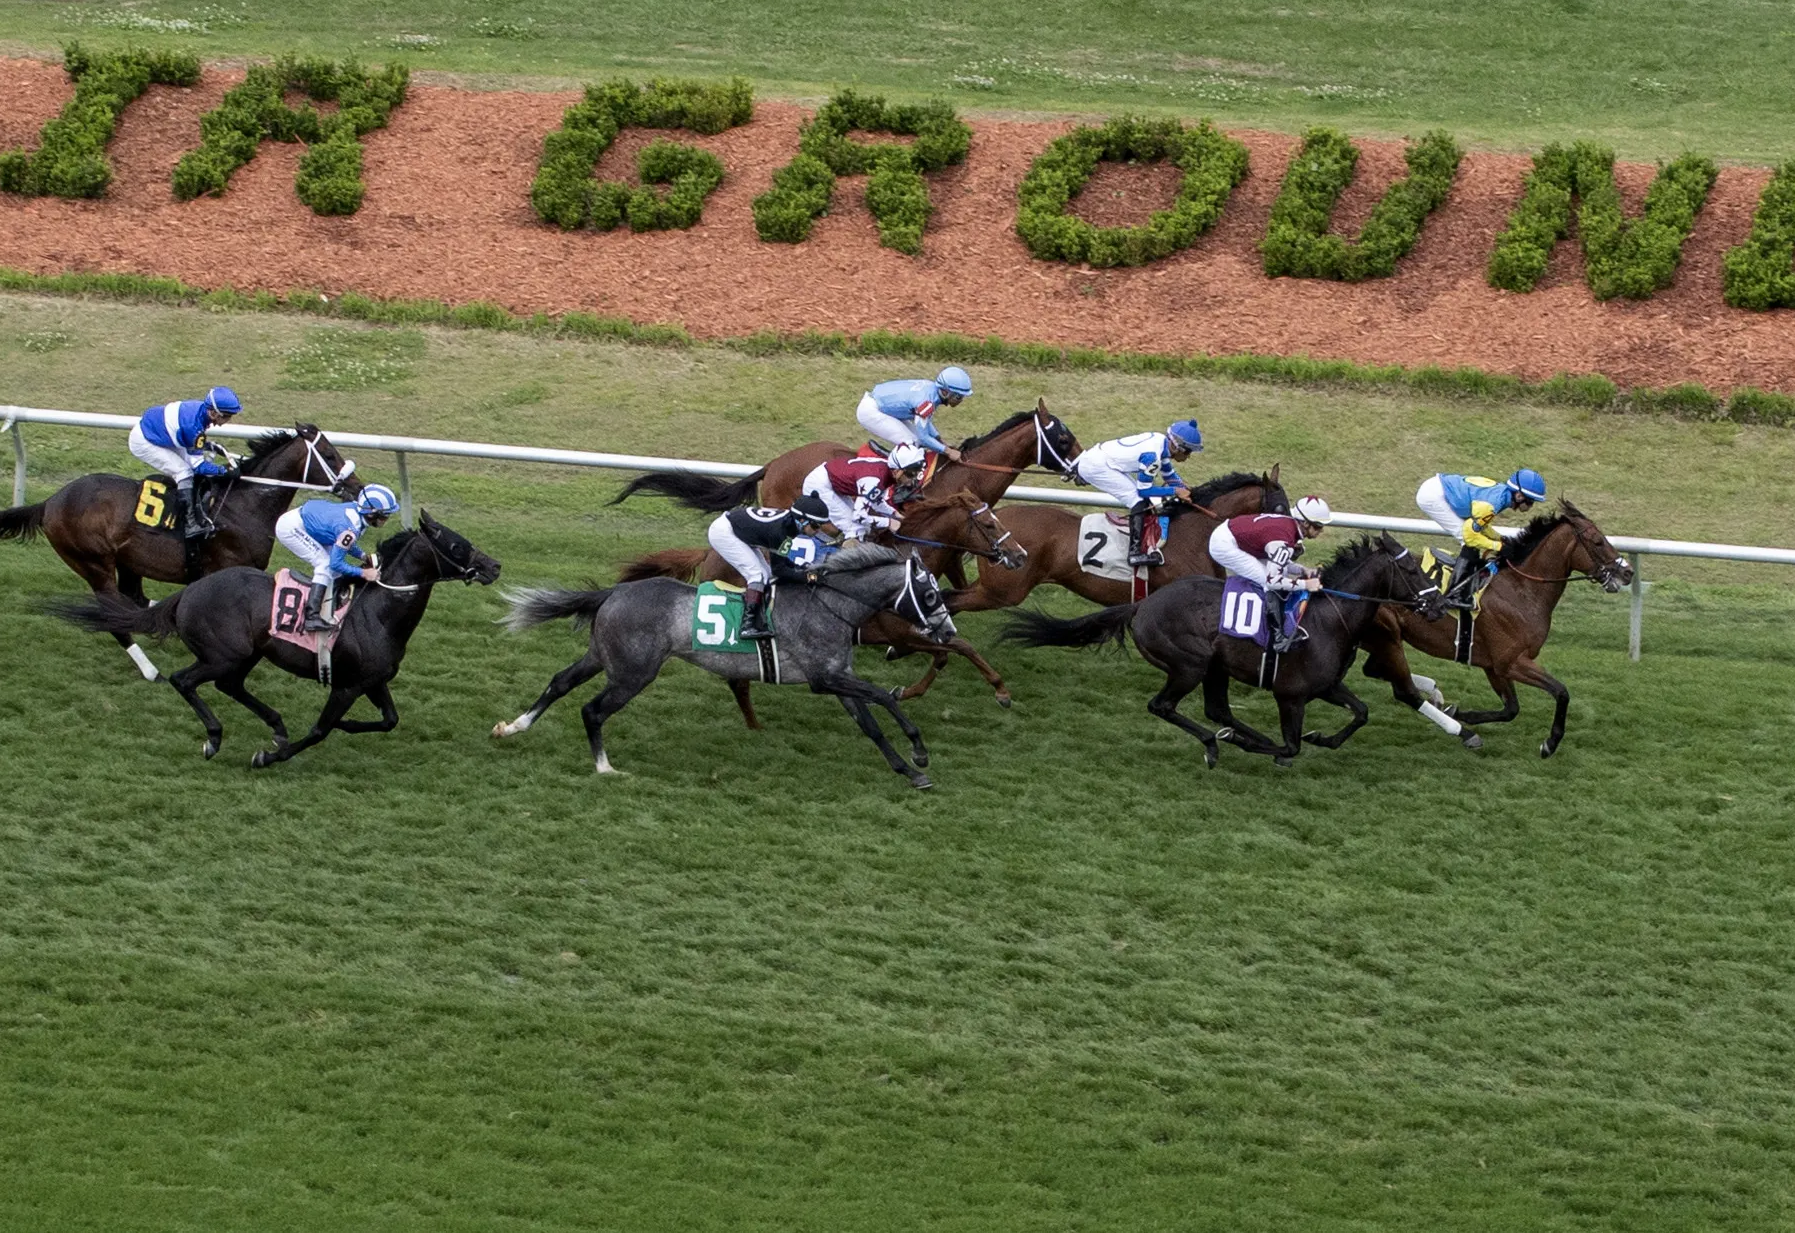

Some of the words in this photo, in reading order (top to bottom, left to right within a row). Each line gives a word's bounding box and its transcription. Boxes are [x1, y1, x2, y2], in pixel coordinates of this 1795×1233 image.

[197, 435, 205, 448] 6
[1149, 464, 1158, 474] 2
[869, 488, 882, 500] 3
[135, 480, 167, 527] 6
[342, 534, 353, 546] 8
[781, 541, 791, 554] 5
[1082, 531, 1108, 568] 2
[1272, 547, 1290, 565] 10
[276, 587, 303, 633] 8
[1223, 591, 1263, 635] 10
[696, 594, 727, 645] 5
